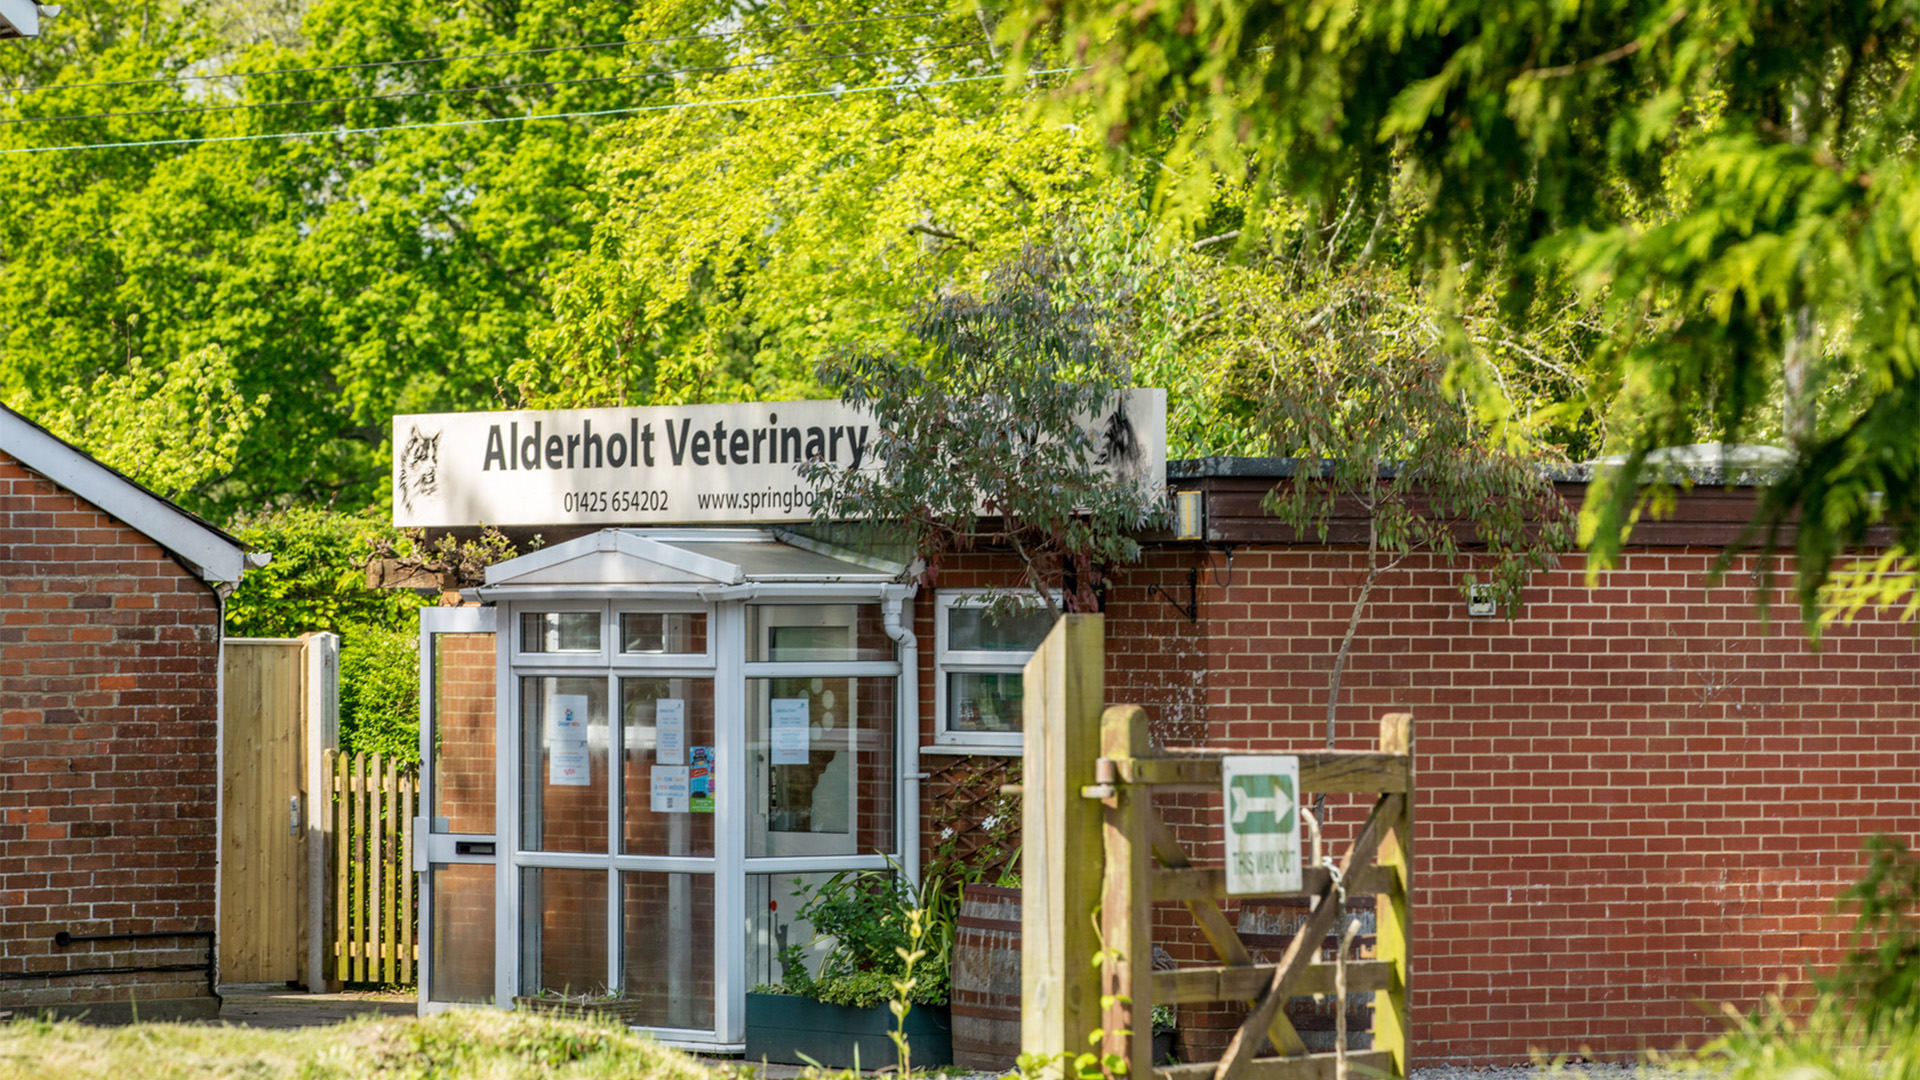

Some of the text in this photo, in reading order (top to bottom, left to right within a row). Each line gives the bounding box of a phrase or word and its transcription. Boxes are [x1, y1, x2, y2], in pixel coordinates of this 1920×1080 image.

[483, 418, 655, 472] Alderholt
[665, 412, 869, 471] Veterinary
[564, 490, 669, 512] 01425 654202
[1232, 849, 1297, 876] THIS WAY OUT
